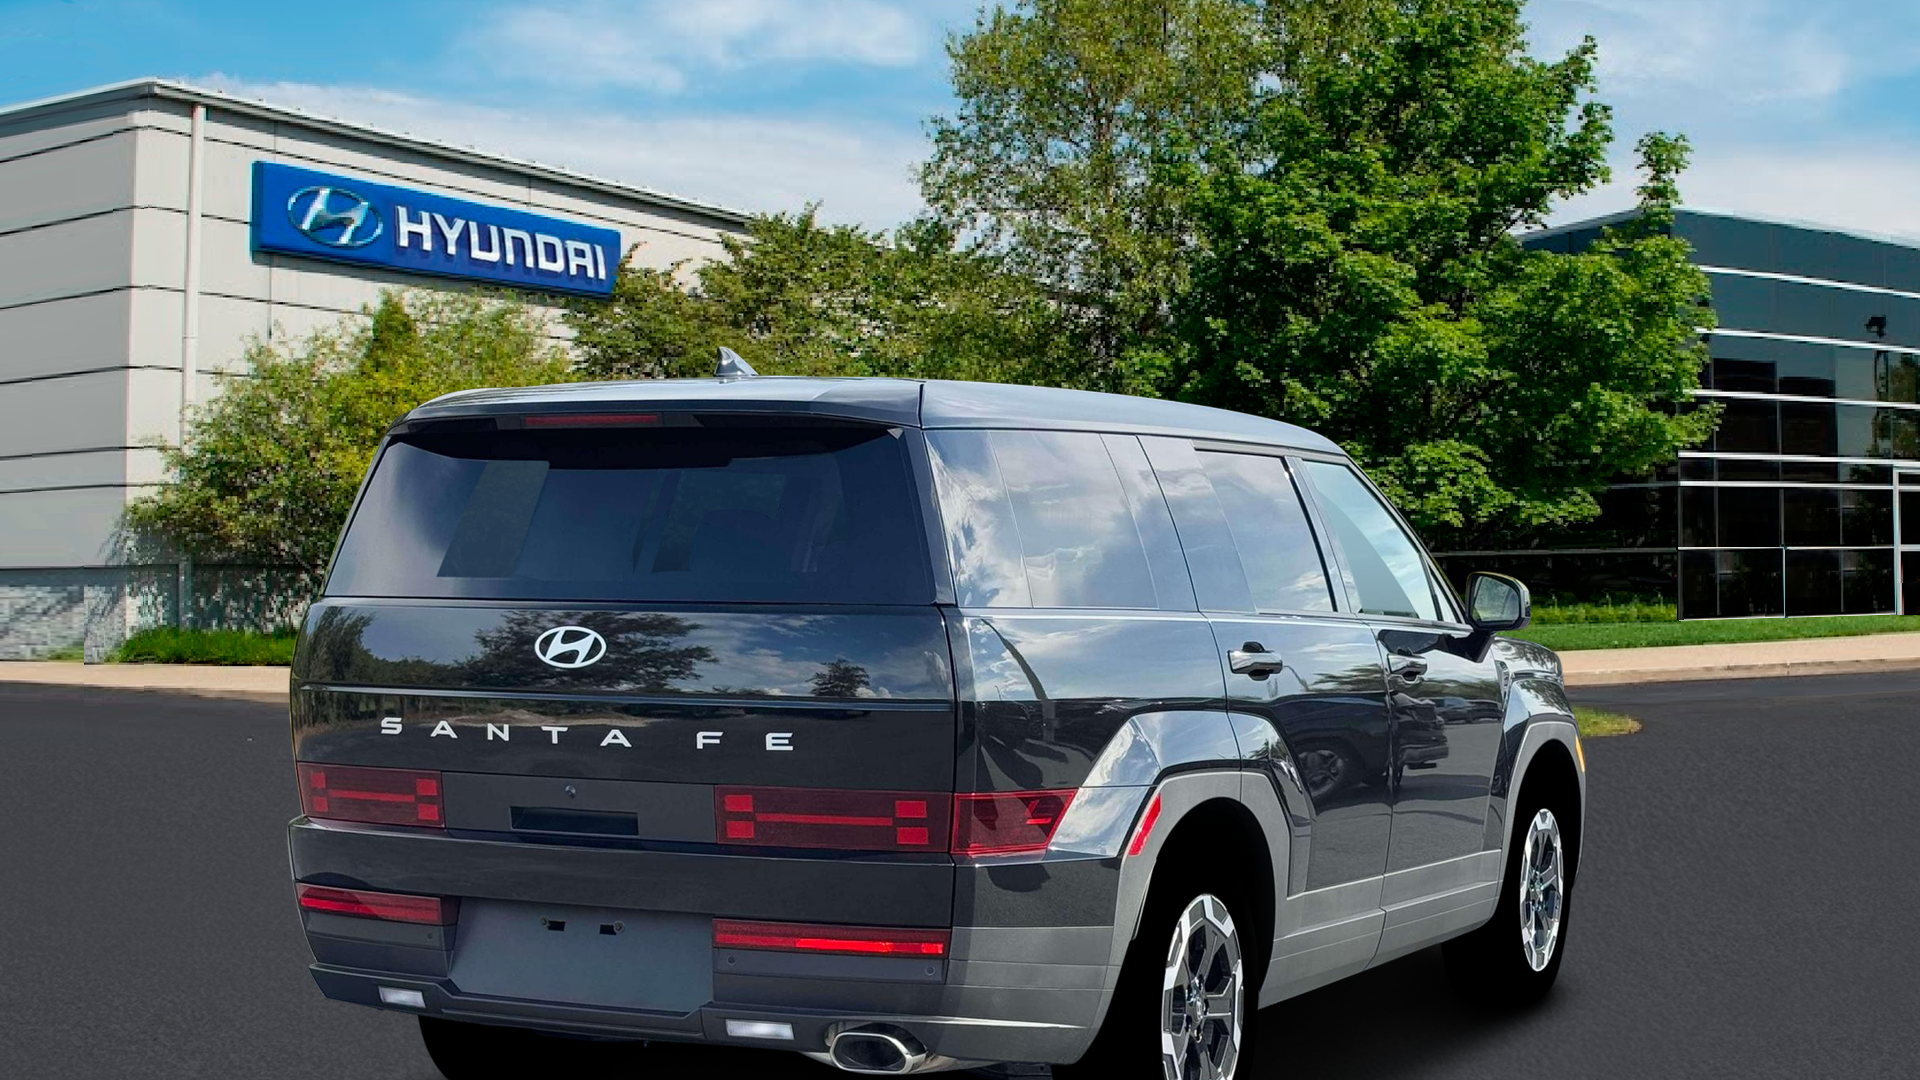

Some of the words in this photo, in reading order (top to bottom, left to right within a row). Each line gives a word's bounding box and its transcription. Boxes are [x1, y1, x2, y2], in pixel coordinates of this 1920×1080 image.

[396, 206, 606, 280] HYUNDAI
[380, 717, 632, 748] SANTA
[696, 731, 794, 752] FE
